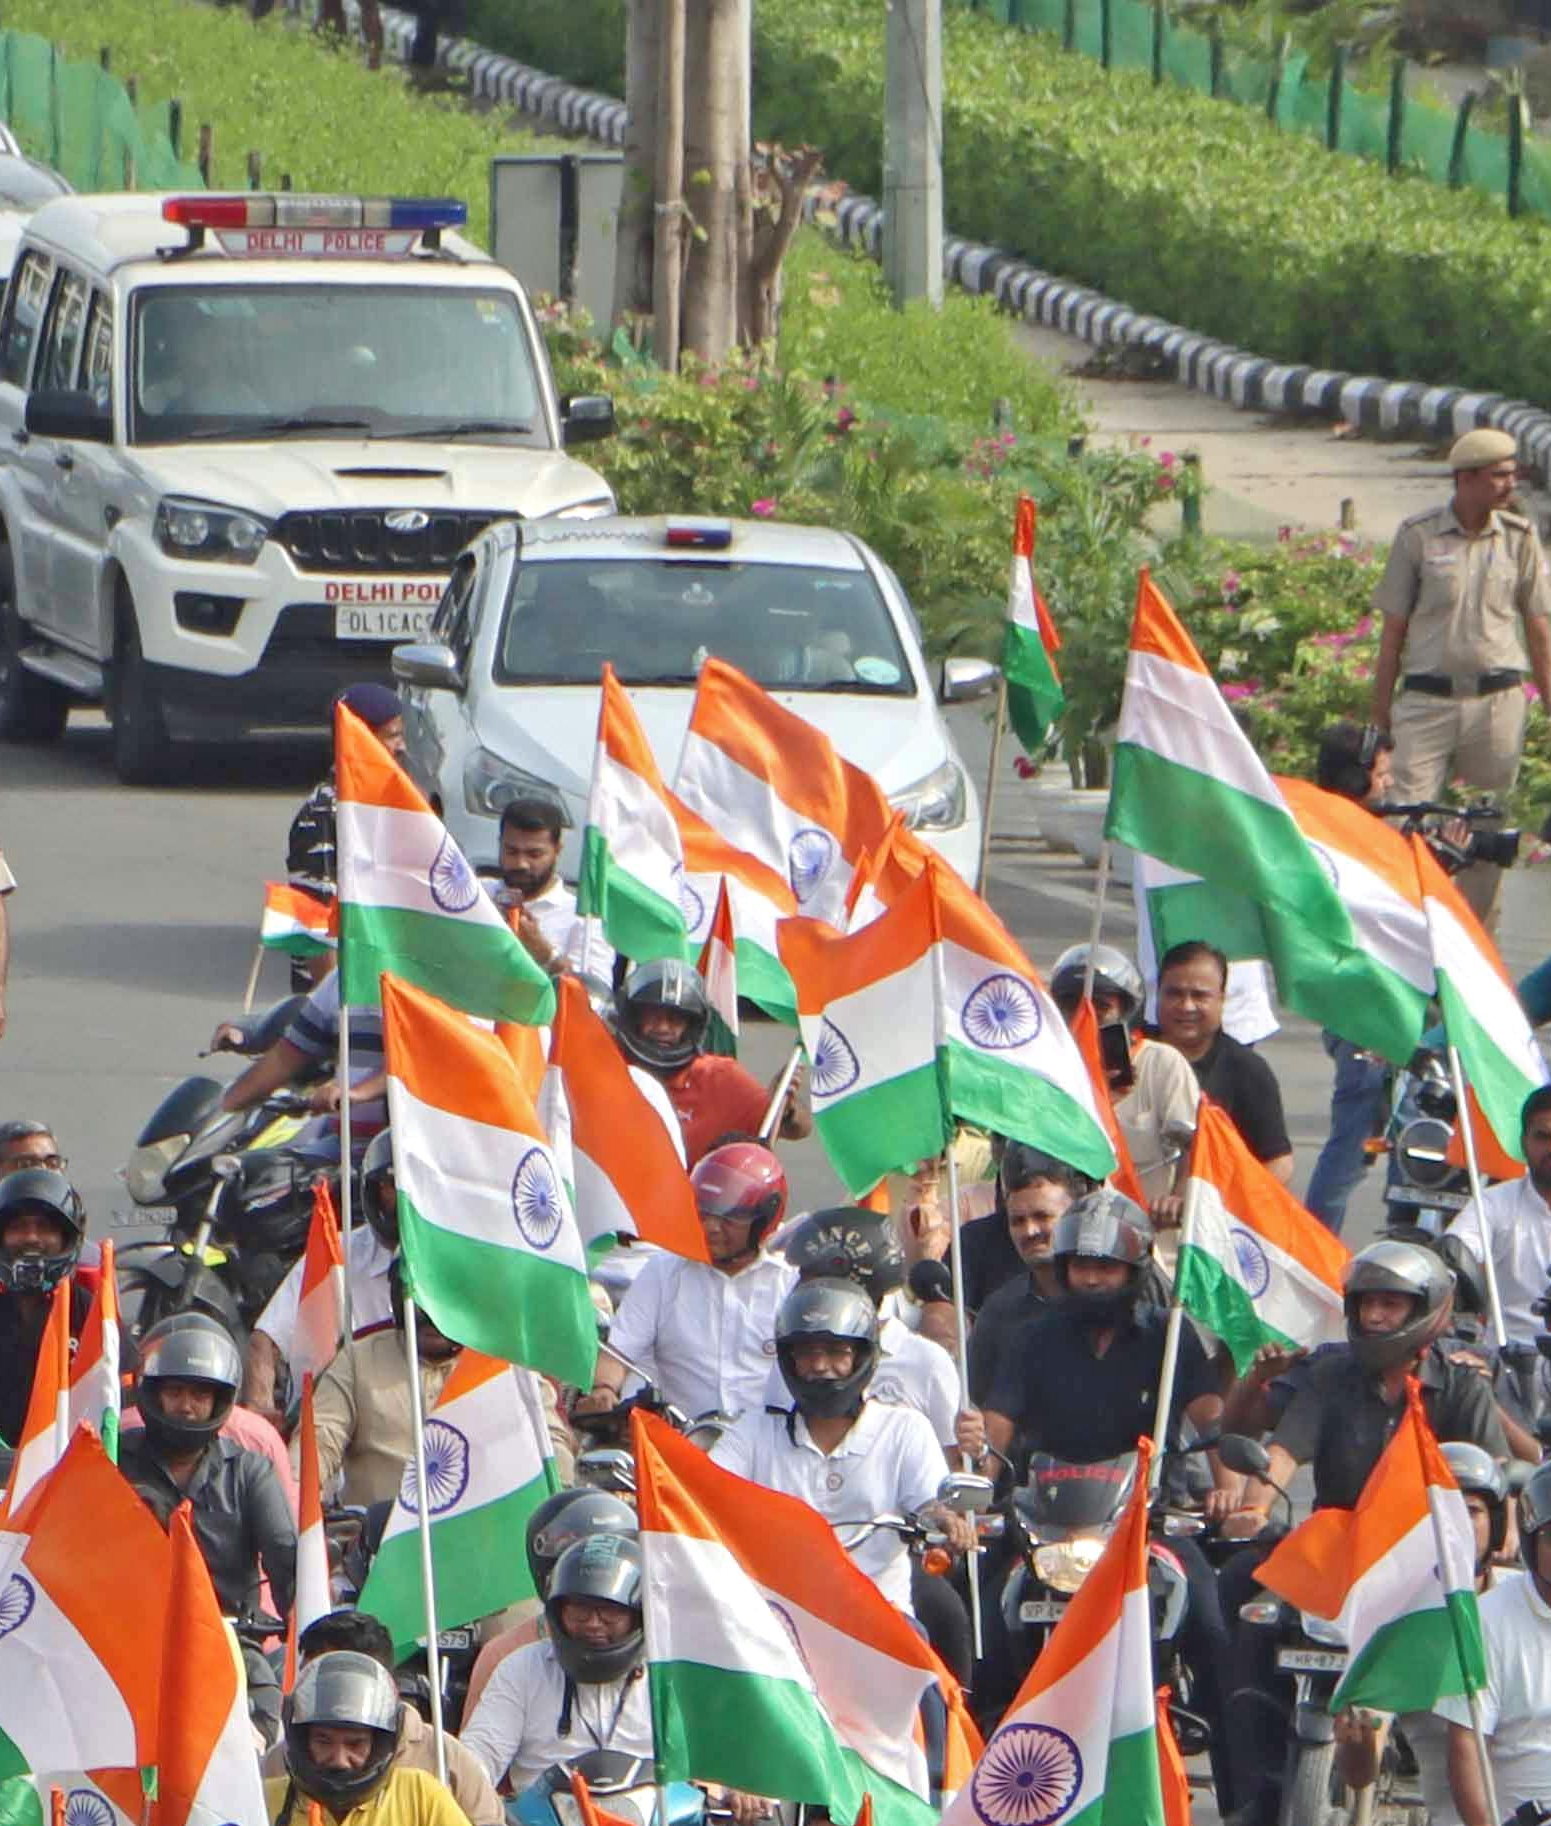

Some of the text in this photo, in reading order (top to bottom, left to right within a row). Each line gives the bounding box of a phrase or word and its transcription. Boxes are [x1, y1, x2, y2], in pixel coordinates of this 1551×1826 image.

[246, 232, 387, 252] DELHI POLICE
[325, 581, 394, 601] DELHI
[804, 1224, 873, 1259] SINCE
